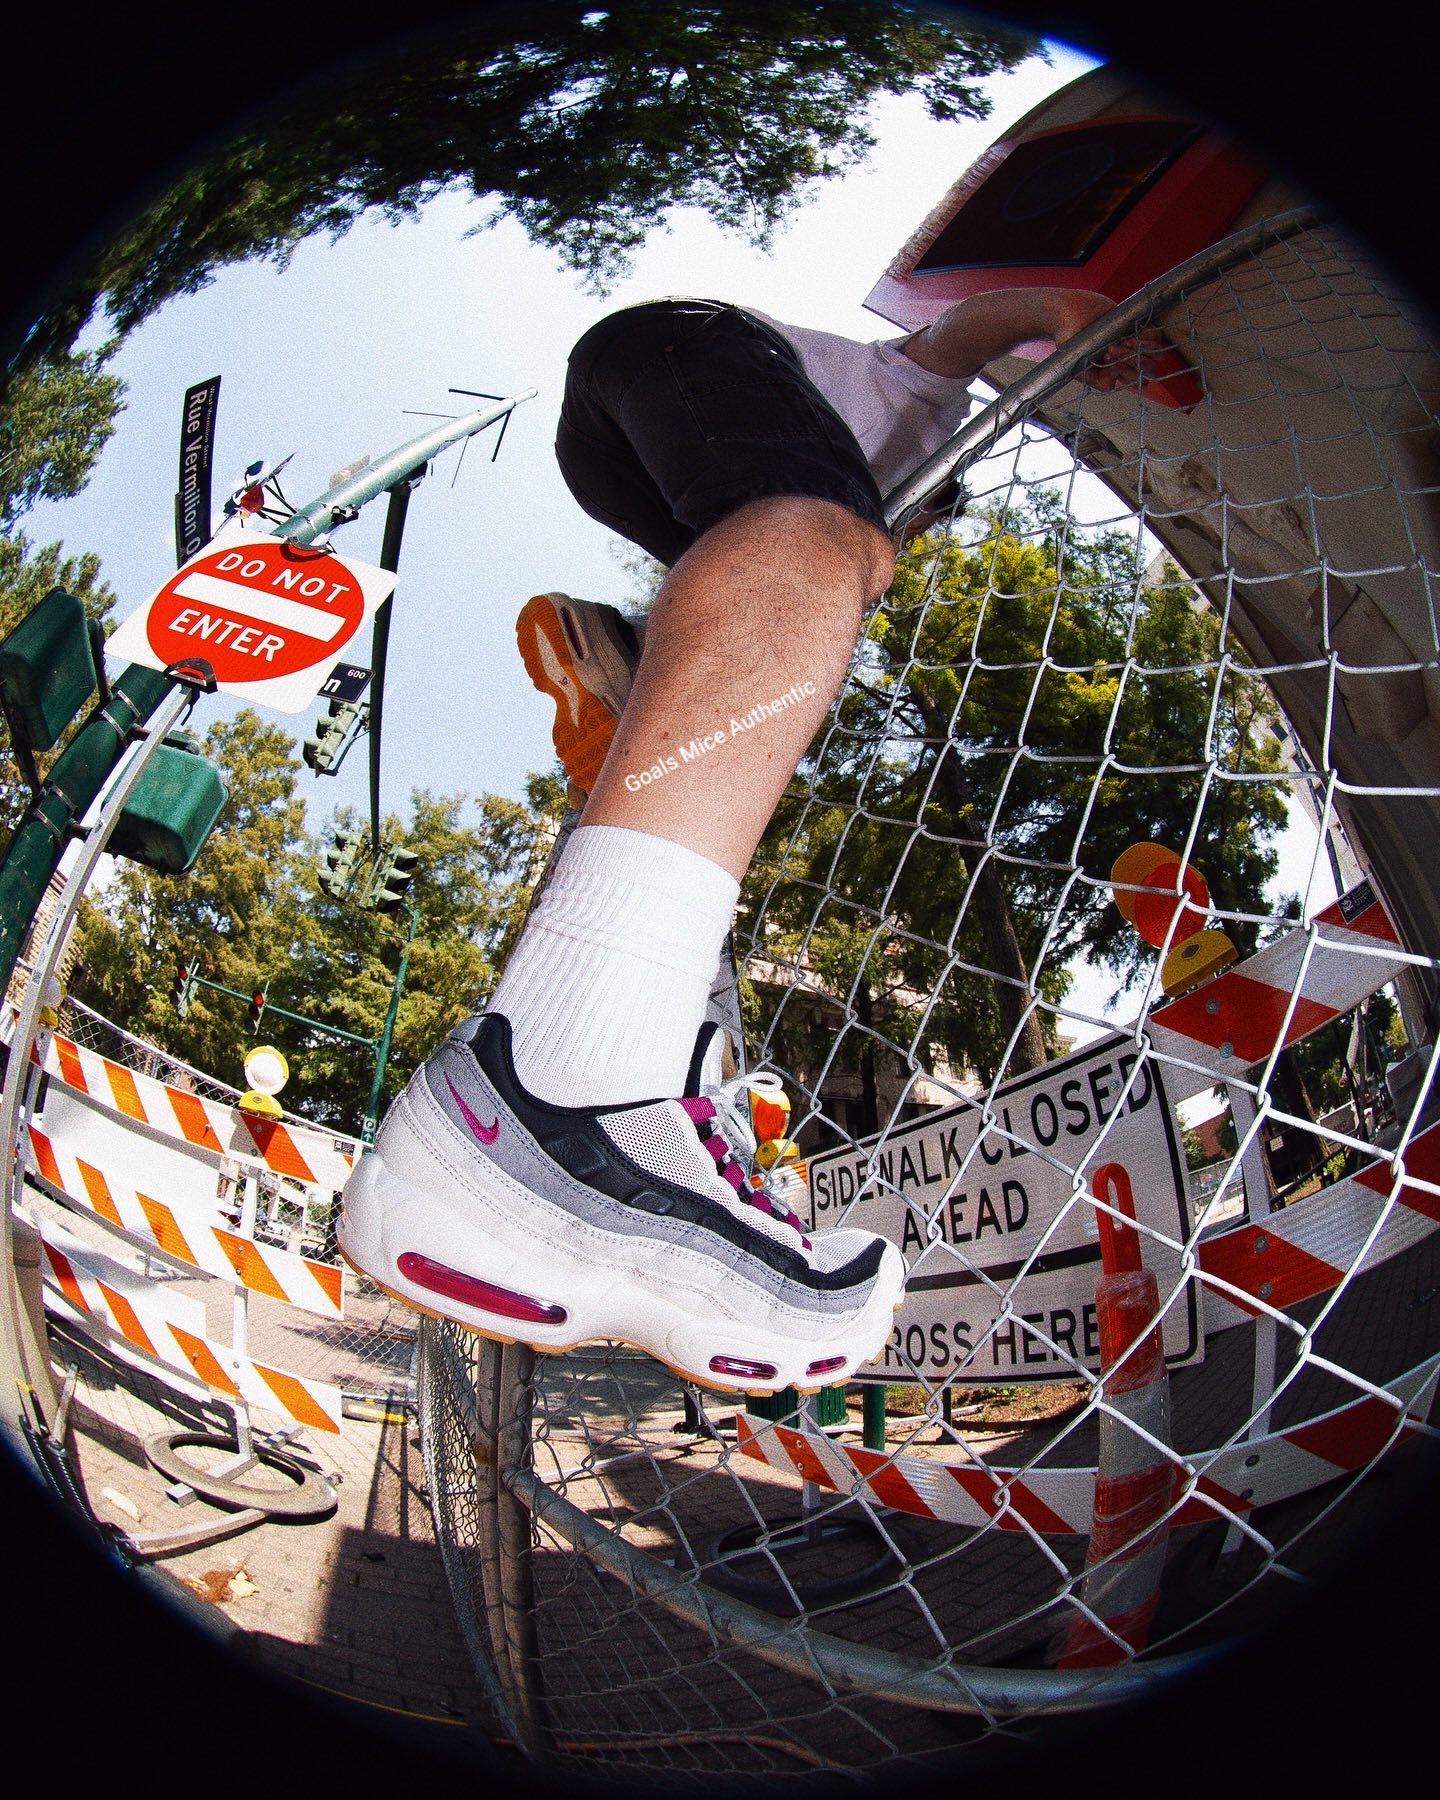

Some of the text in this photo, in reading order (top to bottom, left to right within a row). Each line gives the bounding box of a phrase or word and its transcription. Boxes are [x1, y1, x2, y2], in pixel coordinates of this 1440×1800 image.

[187, 390, 207, 433] Rue
[184, 436, 203, 537] Vermilion
[216, 552, 349, 603] DO NOT
[168, 607, 285, 662] ENTER
[347, 669, 366, 679] 600
[816, 1053, 1152, 1211] SIDEWALK CLOSED
[868, 1303, 1100, 1367] ROSS HERE
